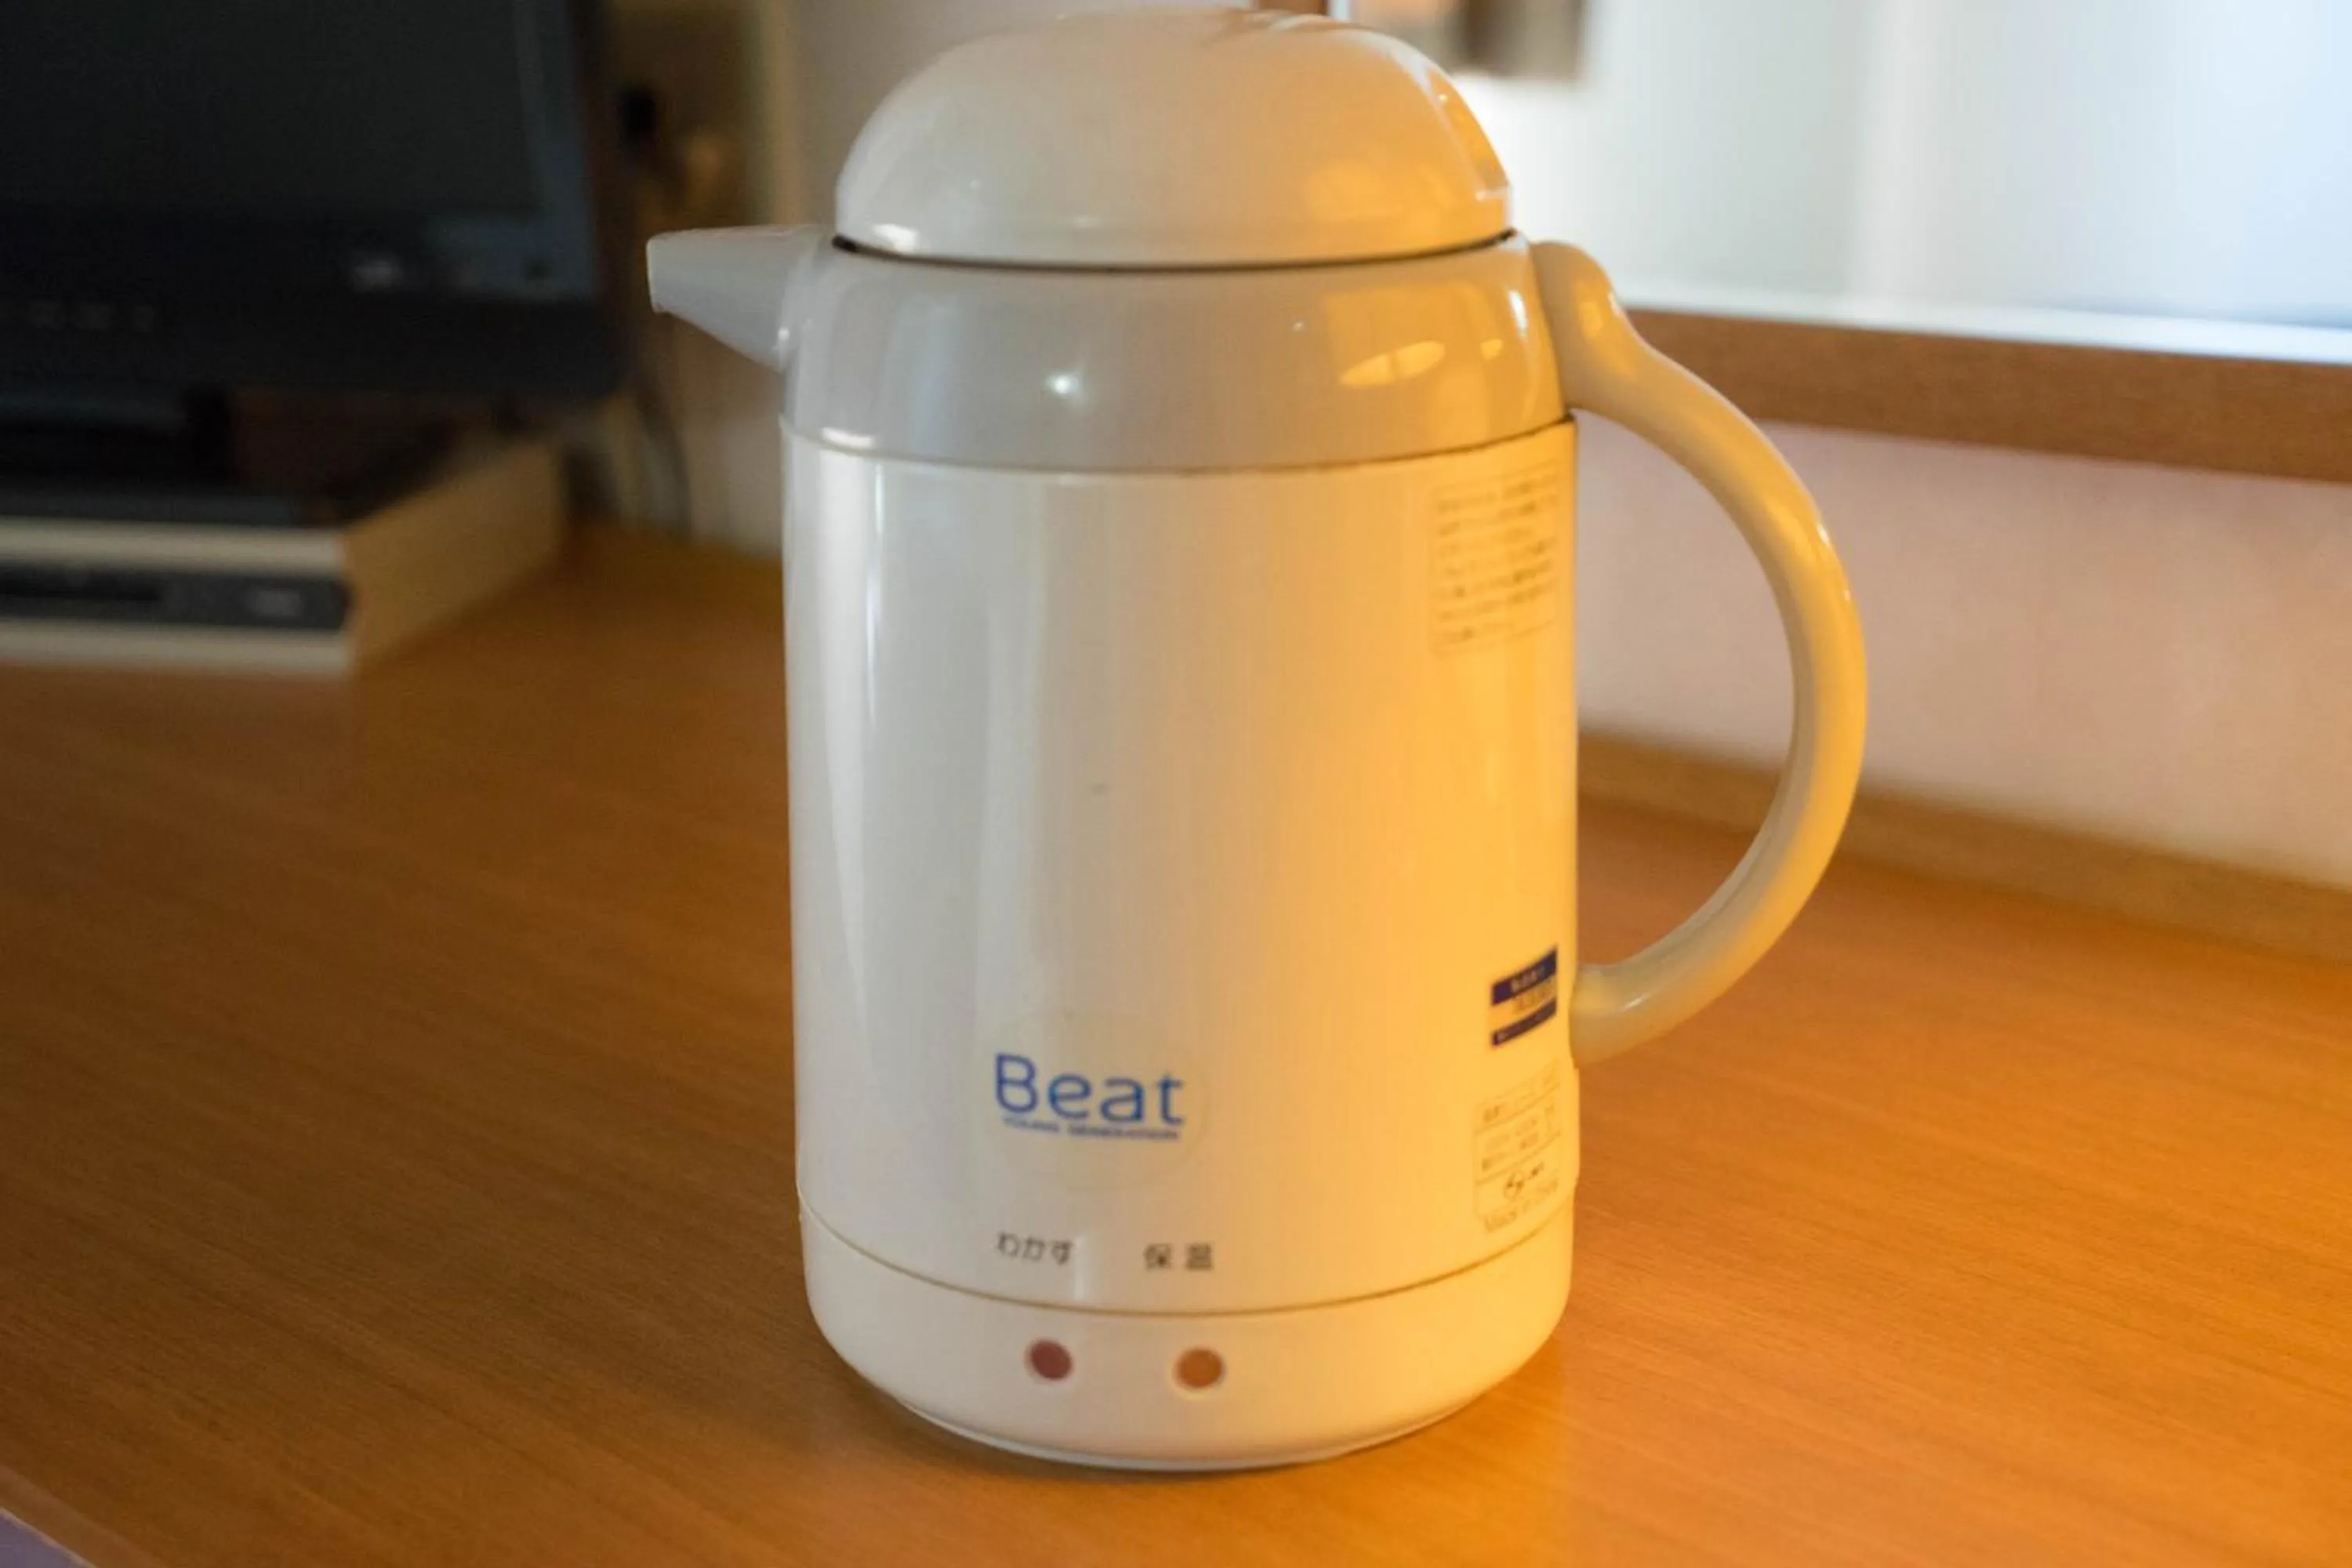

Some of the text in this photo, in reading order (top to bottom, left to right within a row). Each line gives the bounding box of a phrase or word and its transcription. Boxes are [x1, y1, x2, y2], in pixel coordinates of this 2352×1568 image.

[995, 1052, 1185, 1126] Beat
[997, 1232, 1073, 1267] わかす
